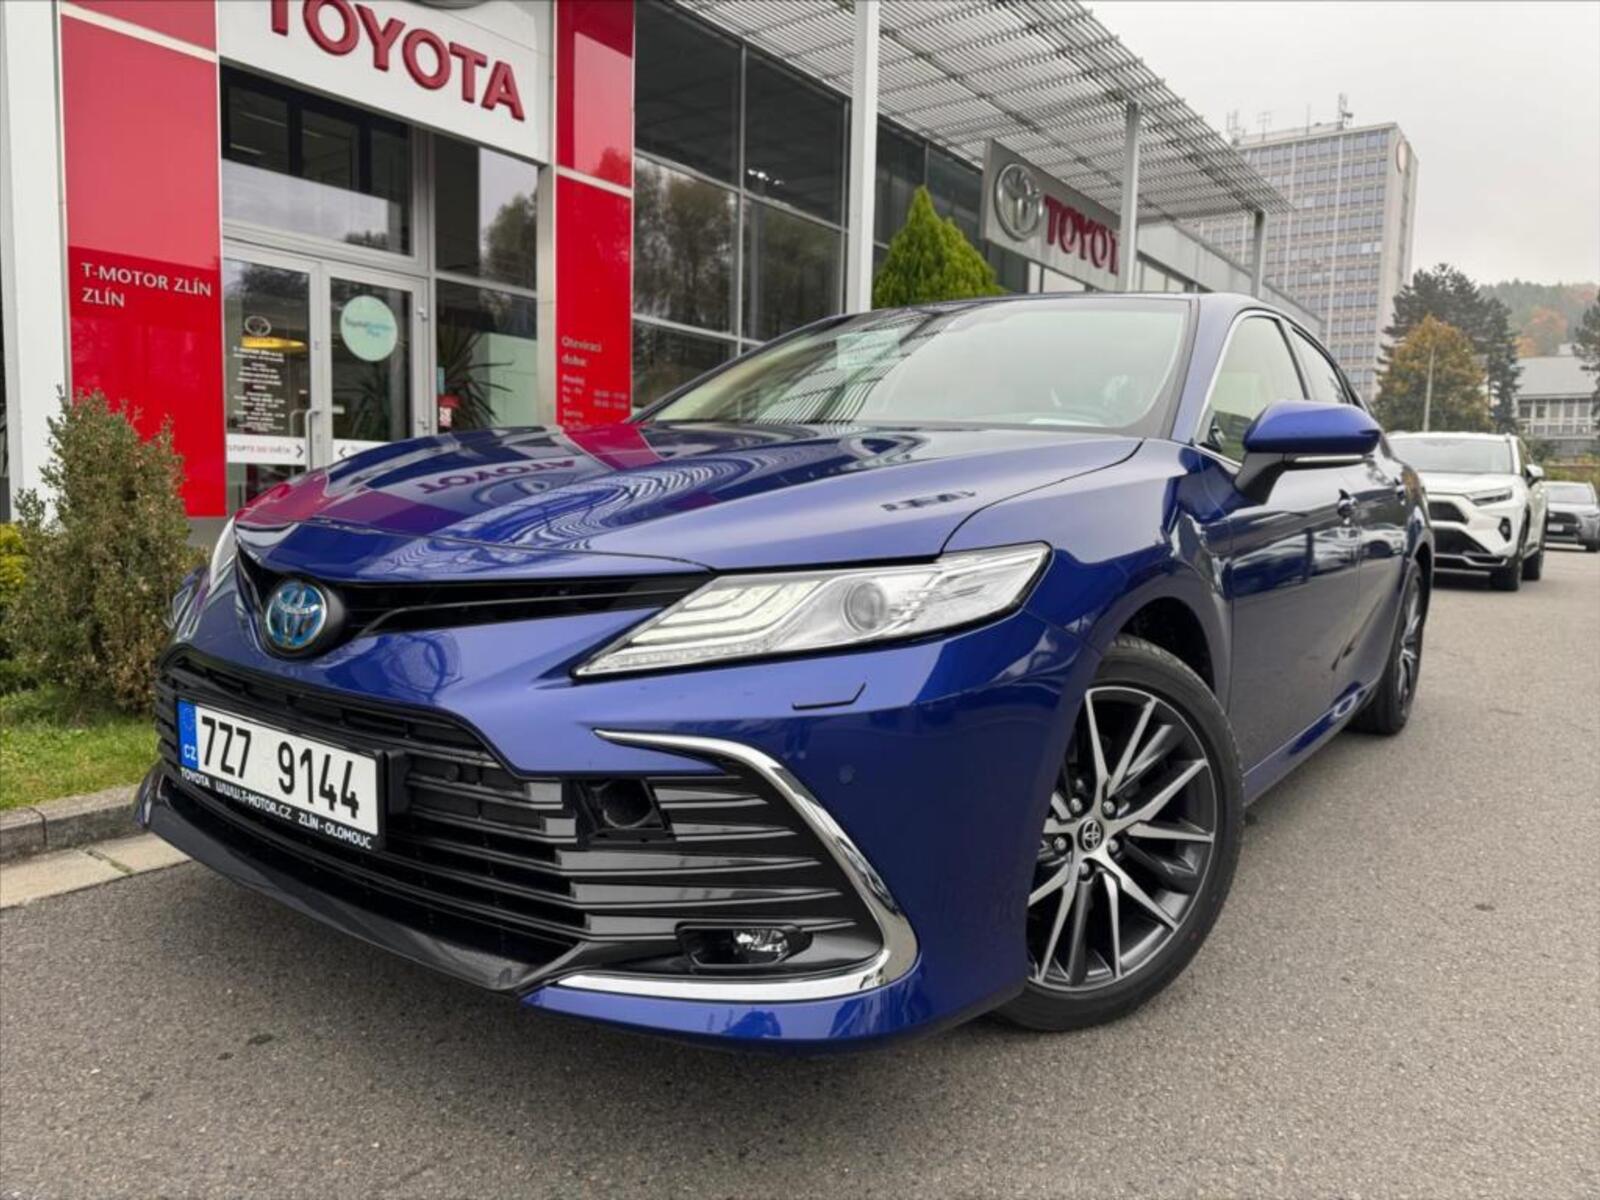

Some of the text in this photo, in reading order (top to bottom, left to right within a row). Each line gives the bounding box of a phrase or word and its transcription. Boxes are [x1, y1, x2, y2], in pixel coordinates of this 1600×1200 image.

[1043, 194, 1119, 277] TOYOT
[80, 261, 212, 297] T-MOTOR ZLÍN
[81, 286, 125, 307] ZLÍN
[184, 744, 197, 761] CZ
[202, 715, 360, 819] 7Z7 9144
